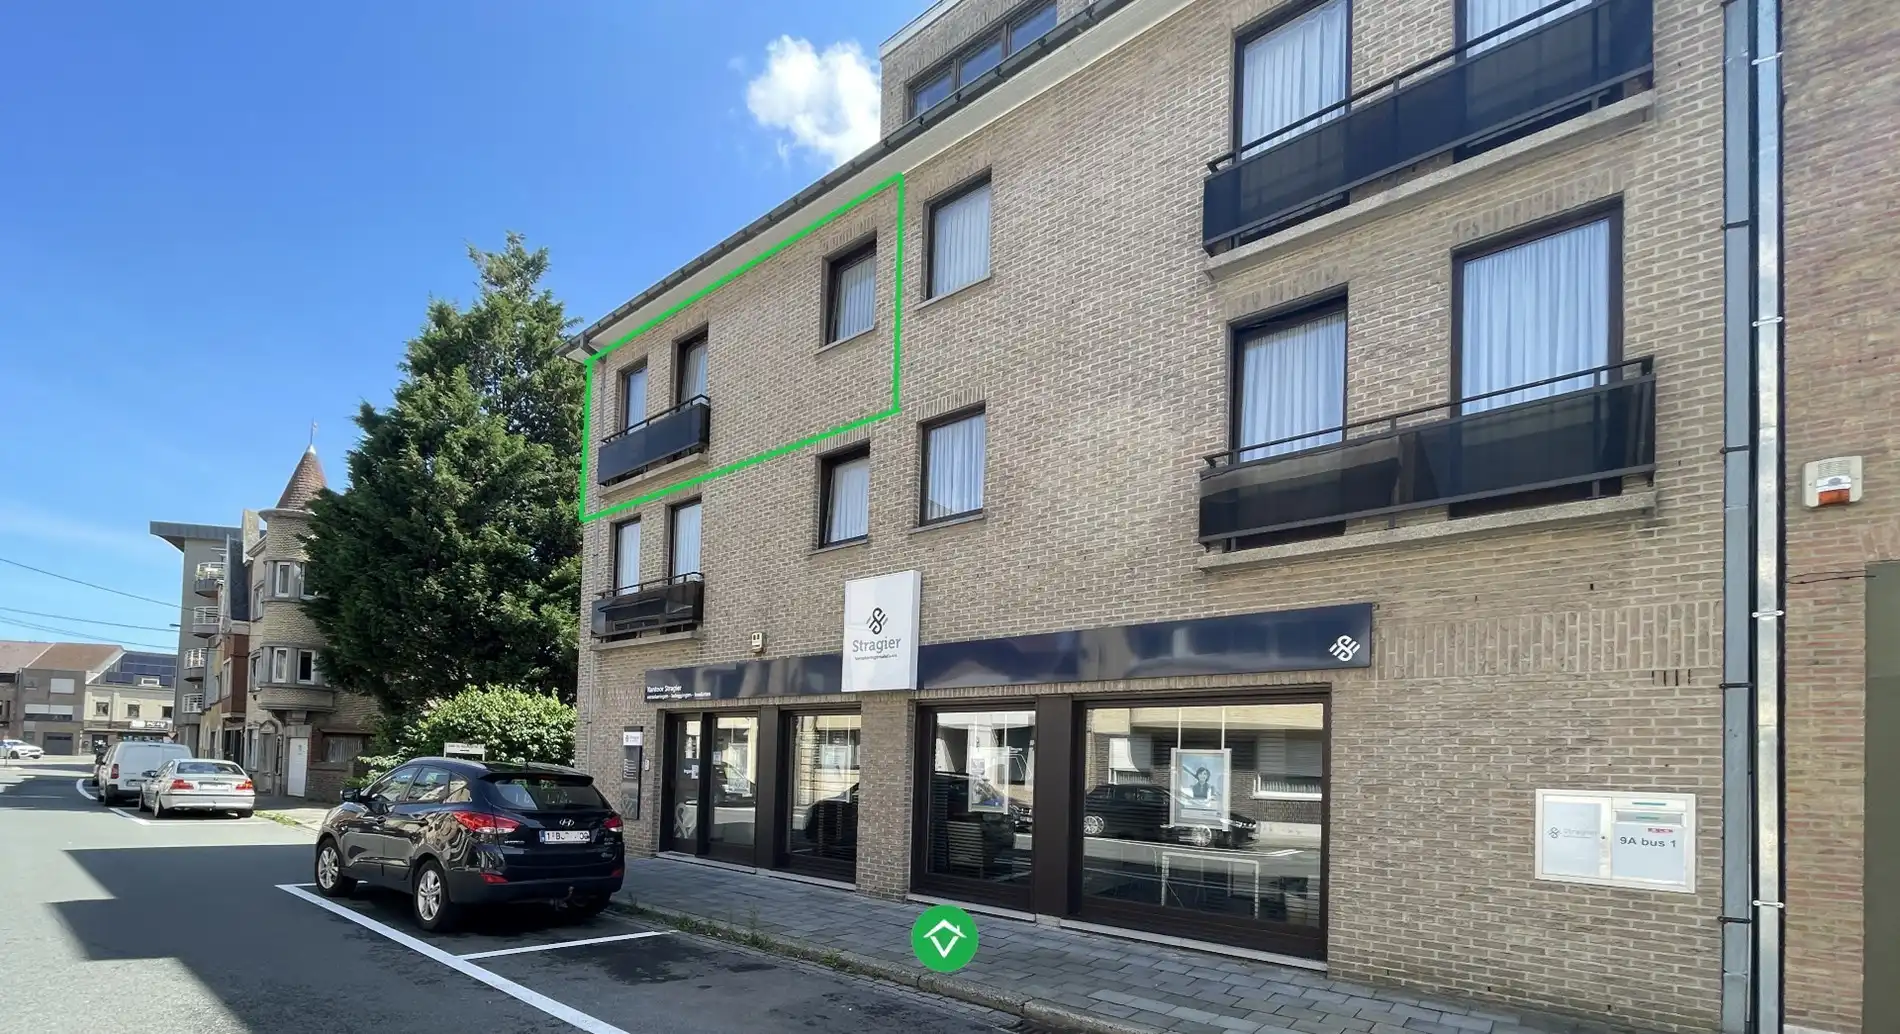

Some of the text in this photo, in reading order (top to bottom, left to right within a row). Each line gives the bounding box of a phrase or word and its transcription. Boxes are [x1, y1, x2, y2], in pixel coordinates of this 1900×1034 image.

[852, 636, 901, 653] Stragier
[646, 684, 682, 693] Kantoor Stragier
[1619, 836, 1677, 848] 9A bus 1
